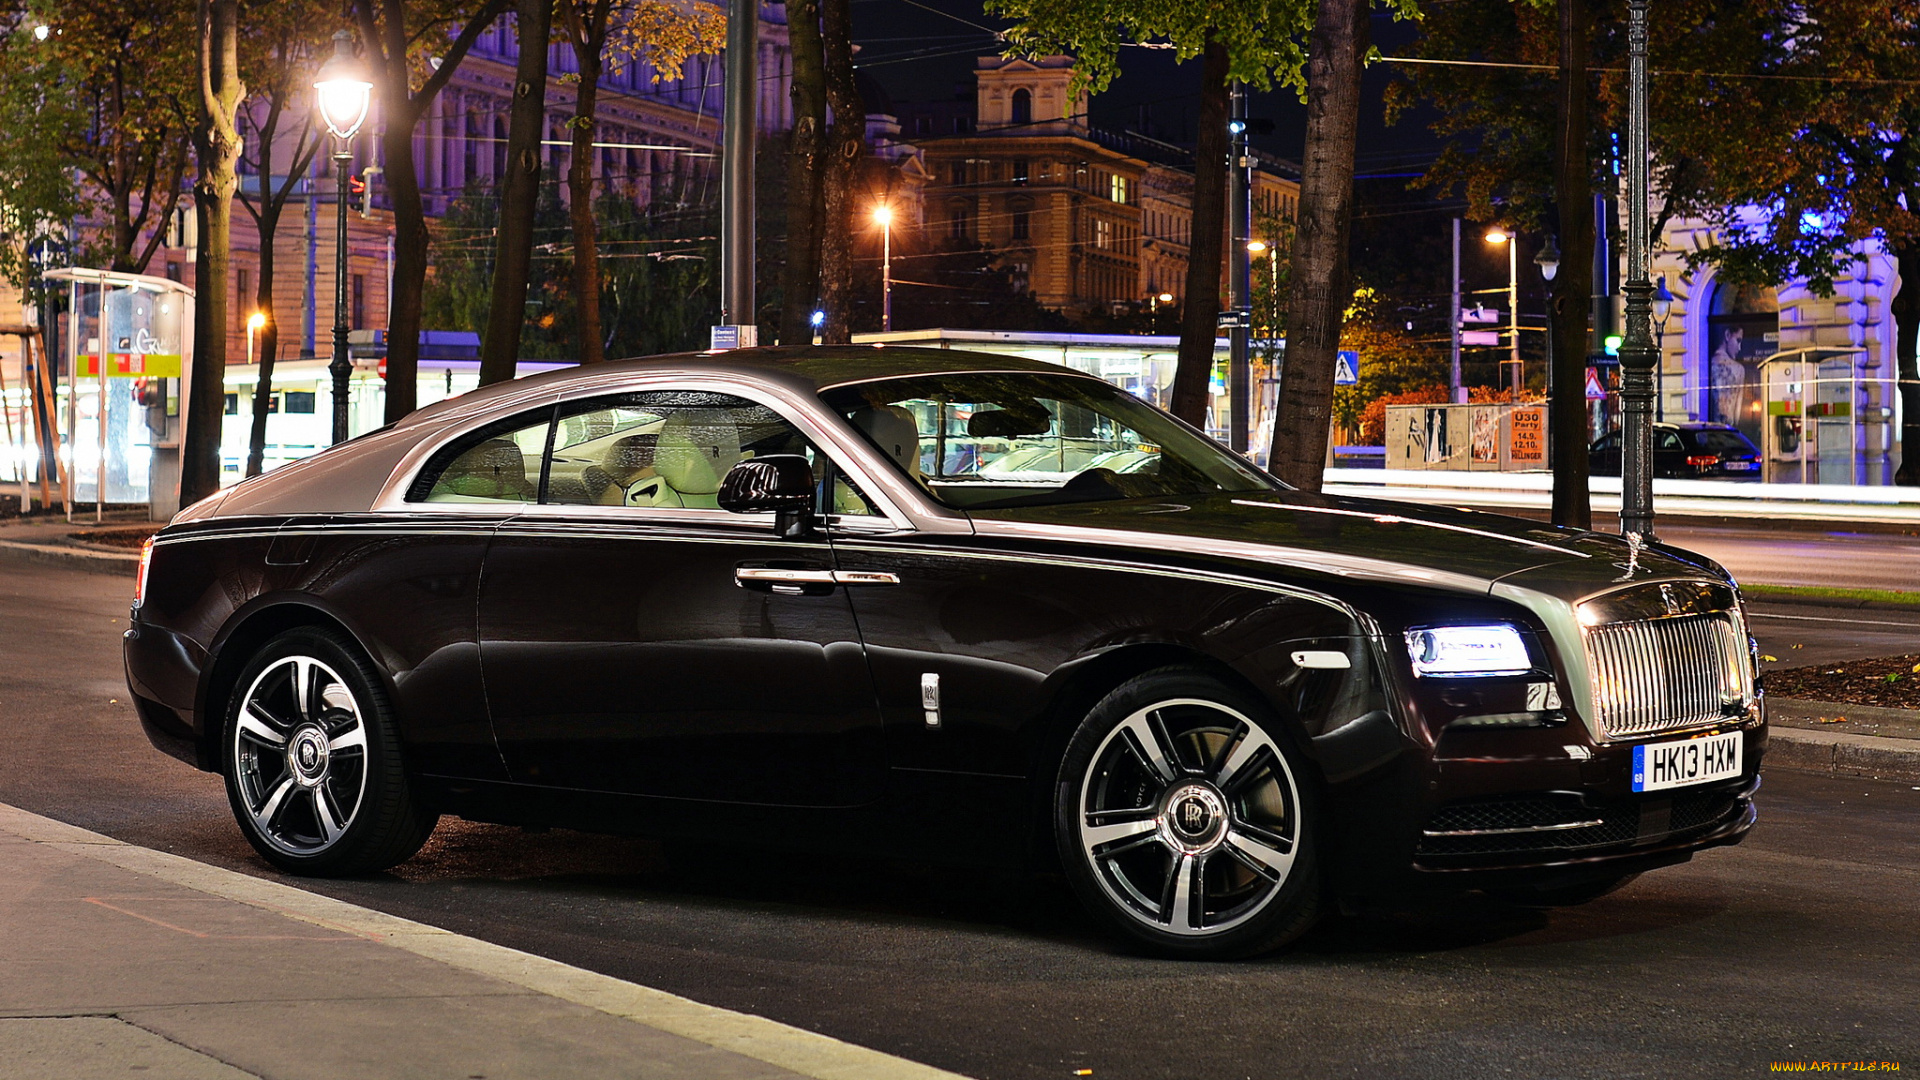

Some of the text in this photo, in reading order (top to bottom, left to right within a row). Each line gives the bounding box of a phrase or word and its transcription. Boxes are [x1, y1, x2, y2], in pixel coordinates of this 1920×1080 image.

[1515, 411, 1539, 421] Ü30
[1653, 737, 1736, 783] HK13 HXM
